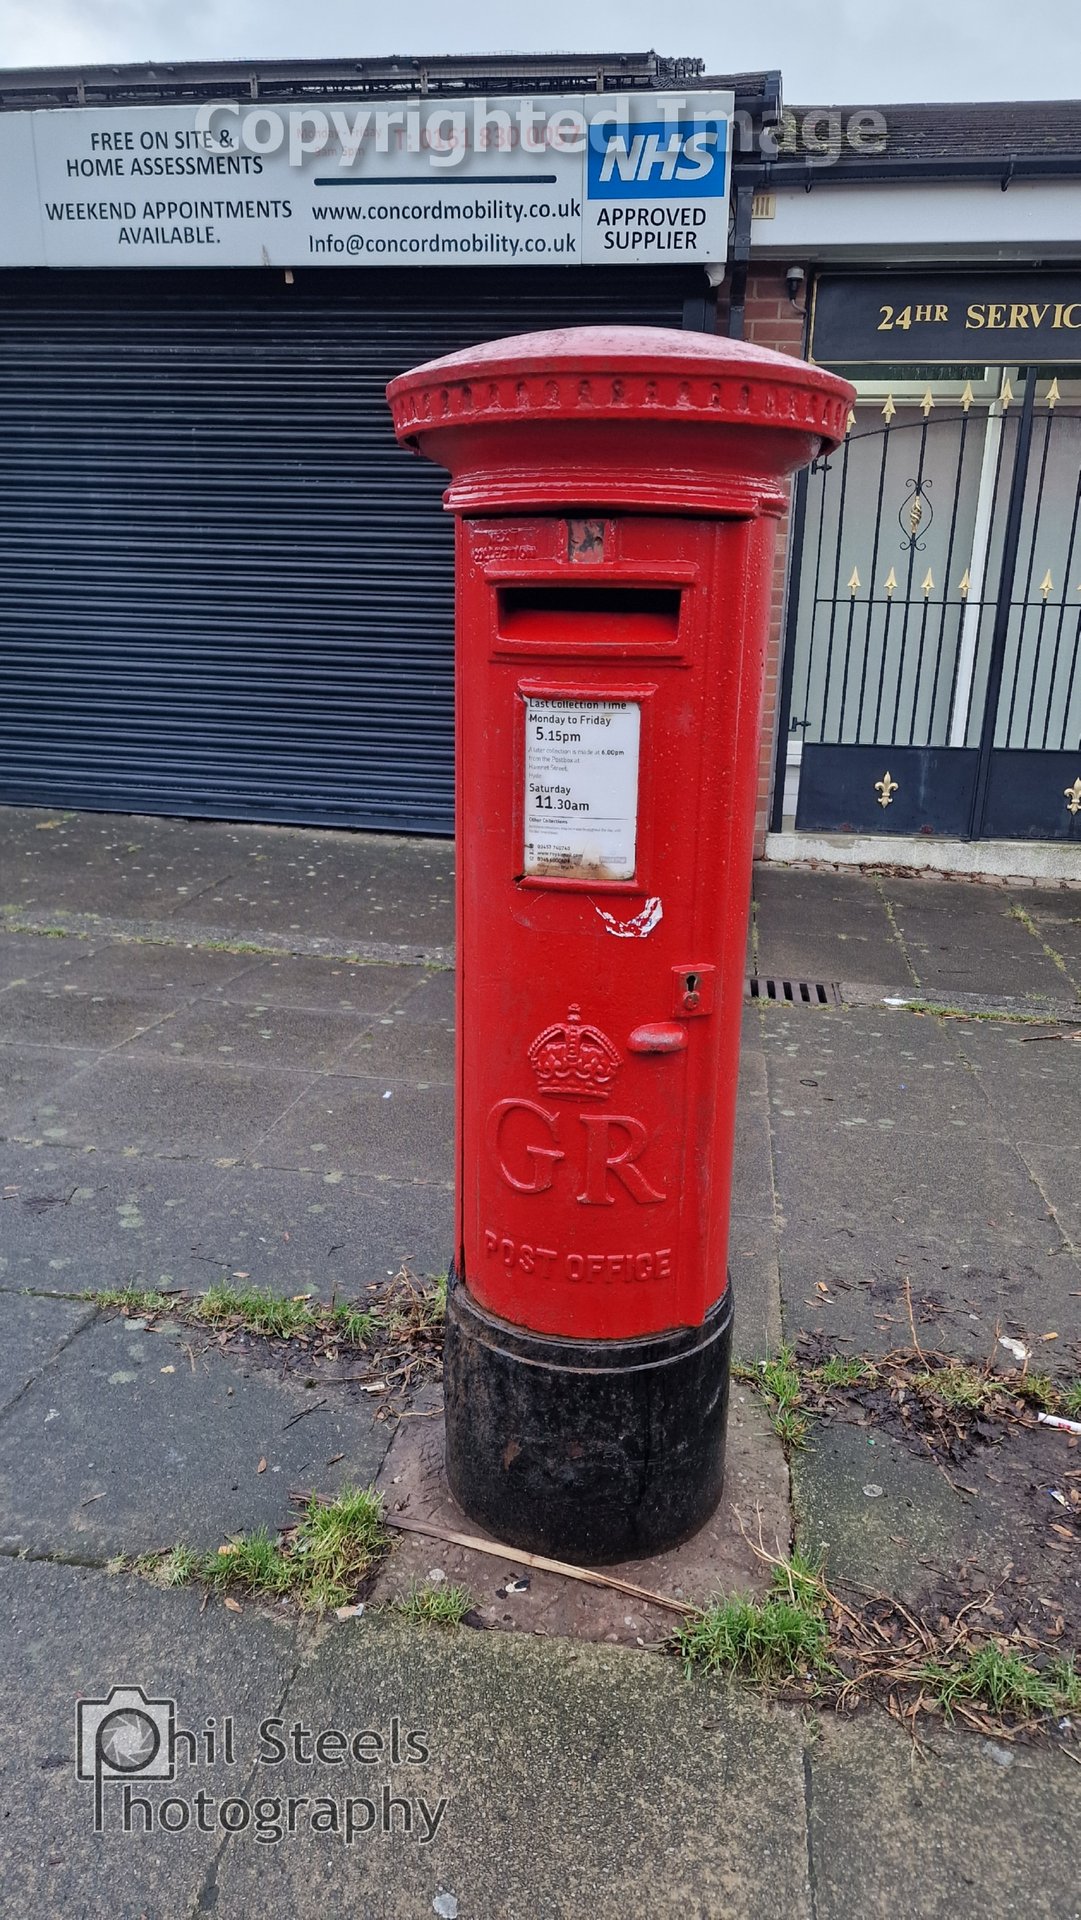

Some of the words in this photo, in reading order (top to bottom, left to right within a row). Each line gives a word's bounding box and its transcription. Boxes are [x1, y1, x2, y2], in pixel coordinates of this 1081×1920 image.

[91, 132, 134, 150] FREE
[140, 131, 169, 149] ON
[174, 130, 213, 149] SITE
[219, 129, 235, 148] &
[66, 158, 125, 177] HOME
[130, 156, 263, 176] ASSESSMENTS
[599, 132, 717, 182] NHS
[45, 202, 137, 221] WEEKEND
[142, 200, 293, 219] APPOINTMENTS
[312, 200, 581, 222] www.concordmobility.co.uk
[596, 207, 707, 226] APPROVED
[118, 226, 221, 245] AVAILABLE.
[309, 232, 576, 257] Info@concordmobility.co.uk
[604, 231, 697, 250] SUPPLIER
[877, 304, 949, 330] 24HR
[529, 698, 549, 708] Last
[551, 699, 599, 710] Collection
[603, 701, 627, 710] Time
[529, 713, 566, 726] Monday
[568, 716, 578, 725] to
[580, 715, 612, 727] Friday
[536, 726, 581, 744] 5.15pm
[529, 783, 571, 795] Saturday
[535, 795, 590, 811] 11.30am
[485, 1098, 667, 1204] GR
[485, 1229, 558, 1279] POST
[567, 1248, 672, 1283] OFFICE
